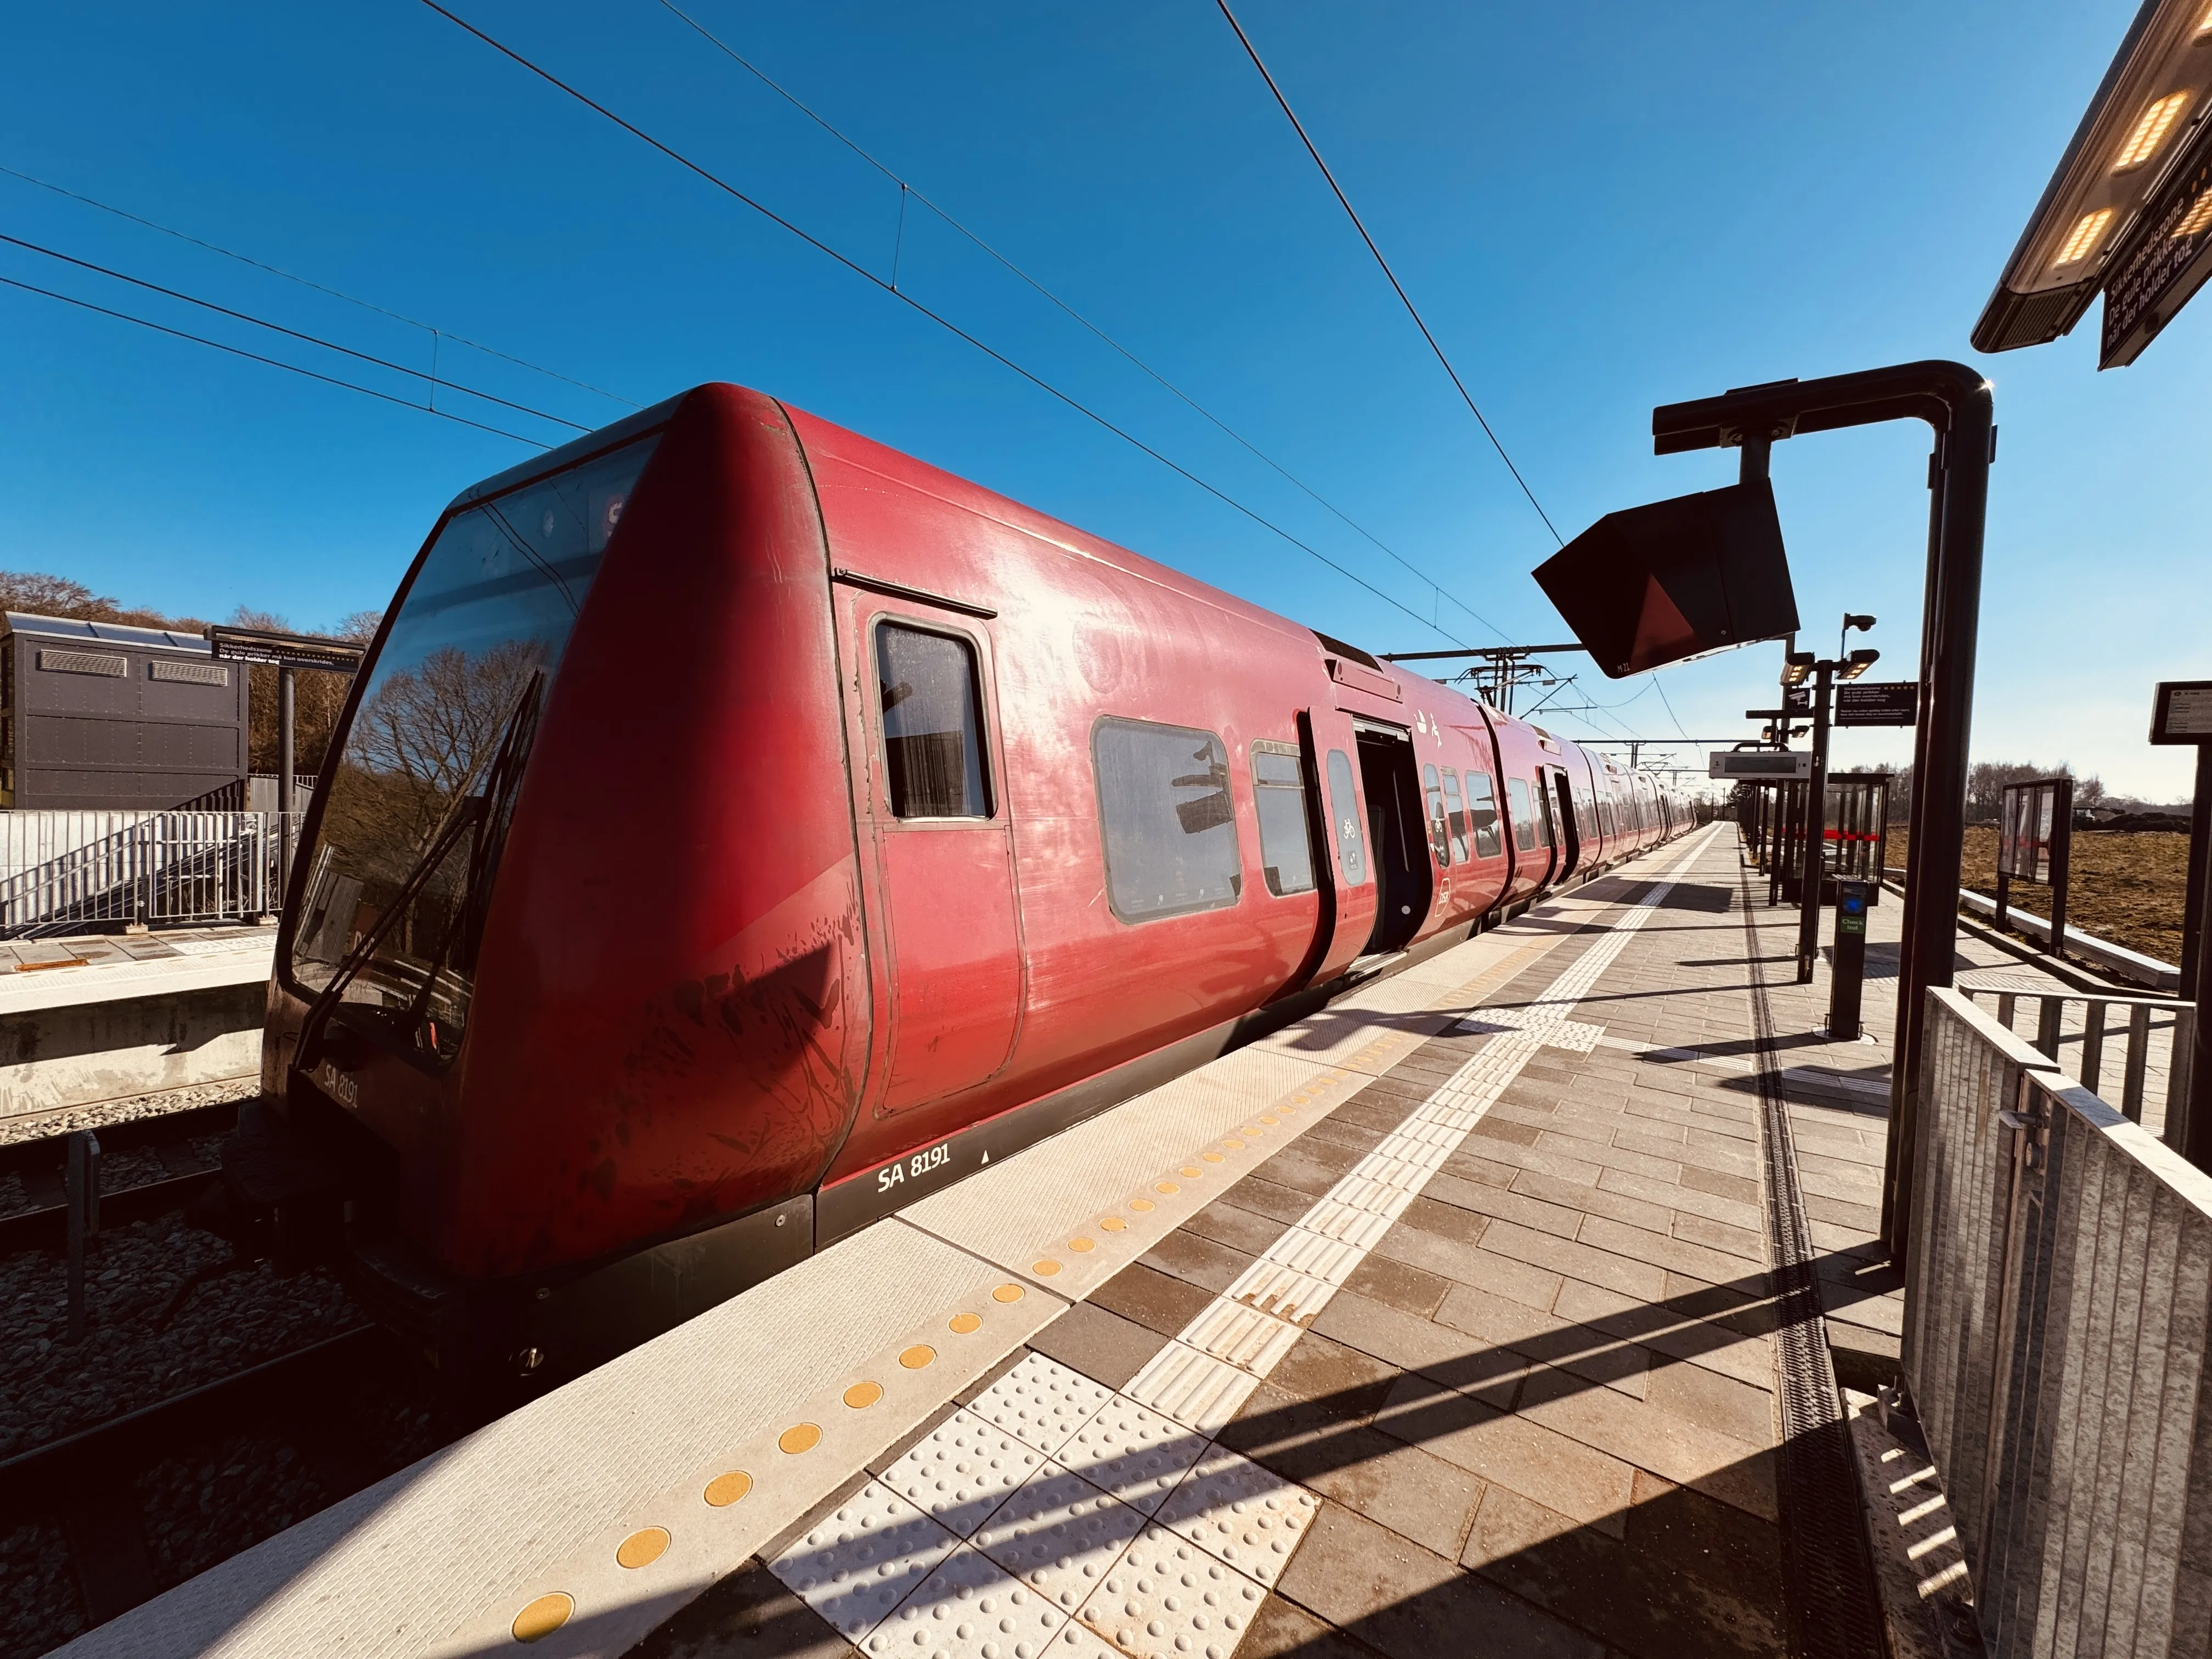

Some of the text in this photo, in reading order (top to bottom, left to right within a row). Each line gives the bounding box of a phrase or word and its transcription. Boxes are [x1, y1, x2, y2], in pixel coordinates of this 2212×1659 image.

[2111, 198, 2184, 303] Sikkerhedszone
[2107, 234, 2193, 349] når der holder tog
[2109, 304, 2120, 326] De
[2122, 277, 2141, 311] gule
[219, 642, 272, 653] Sikkerhedszone
[1617, 662, 1630, 673] M 21
[325, 1064, 358, 1108] SA 8191
[878, 1143, 950, 1193] SA 8191
